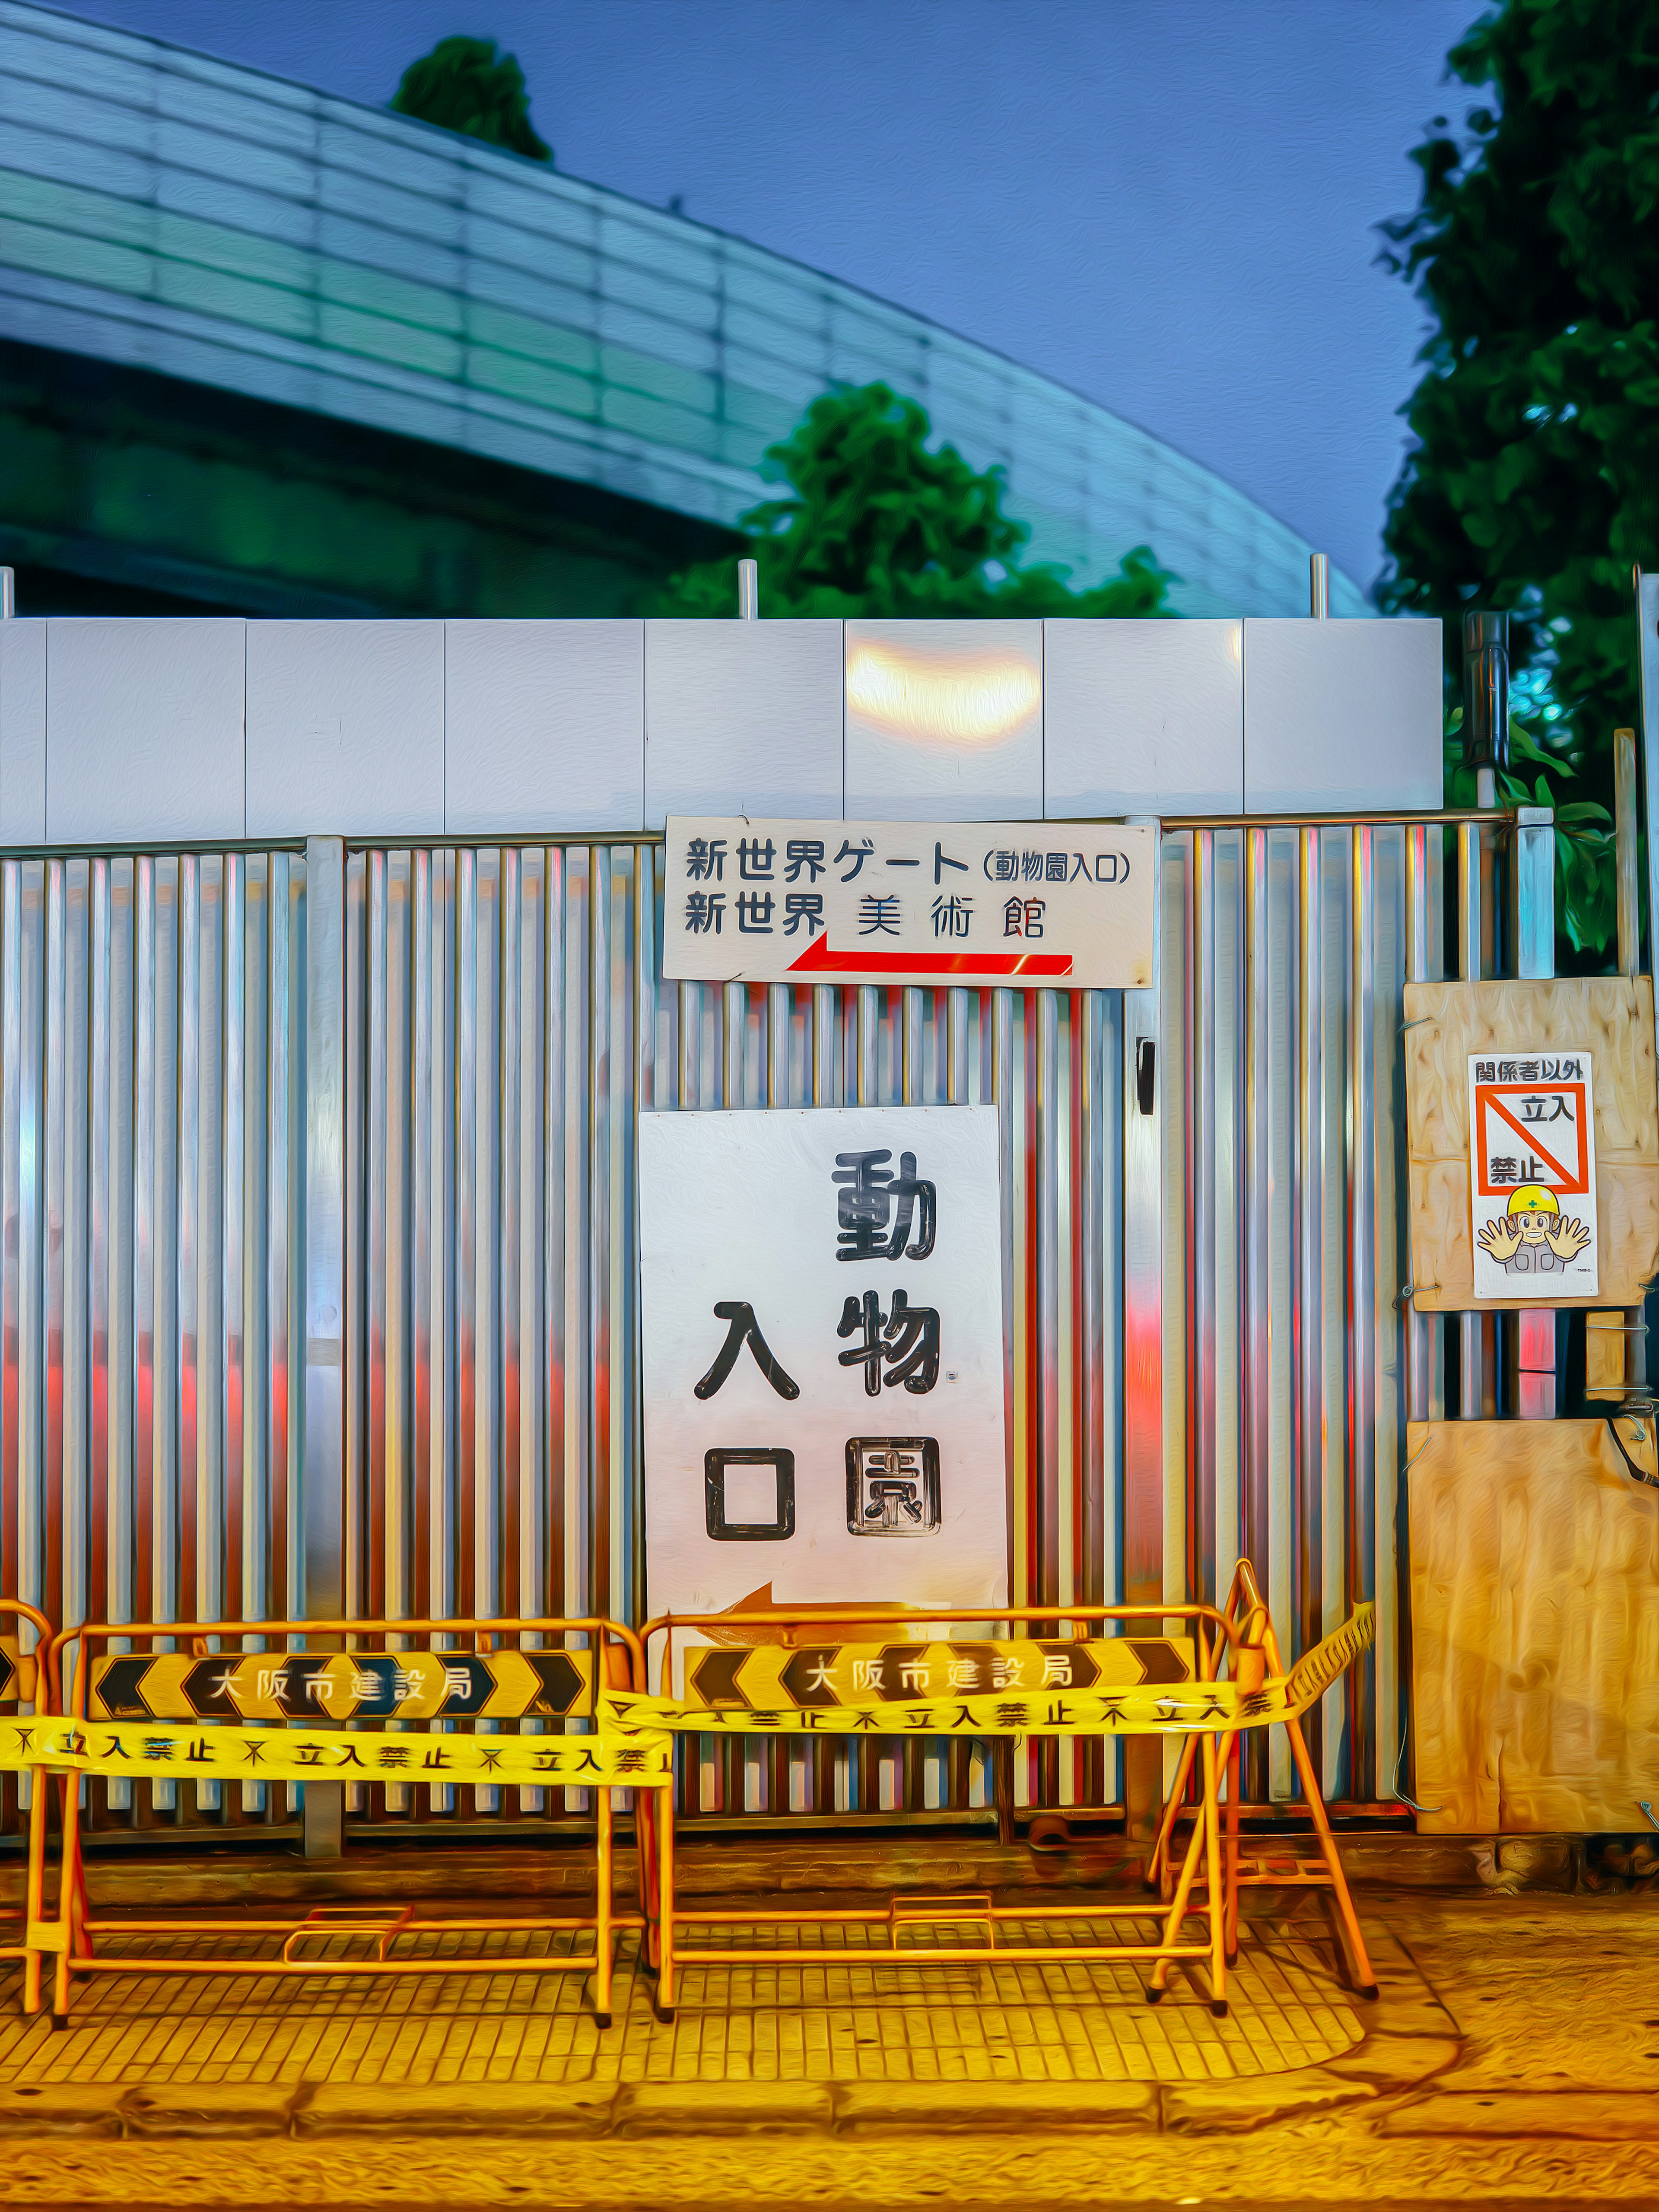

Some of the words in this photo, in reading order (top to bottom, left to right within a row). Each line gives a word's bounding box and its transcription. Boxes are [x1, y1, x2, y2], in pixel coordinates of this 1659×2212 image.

[685, 890, 825, 937] 新世界
[858, 894, 1046, 938] 美術館
[1475, 1059, 1584, 1083] 関係者以外
[1521, 1095, 1575, 1122] 立入
[1490, 1156, 1545, 1184] 禁止
[831, 1149, 941, 1537] 動物園
[693, 1300, 801, 1542] 入口
[210, 1665, 472, 1702] 大阪市建設局
[806, 1653, 1073, 1692] 大阪市建設局
[295, 1742, 451, 1770] 立入禁止
